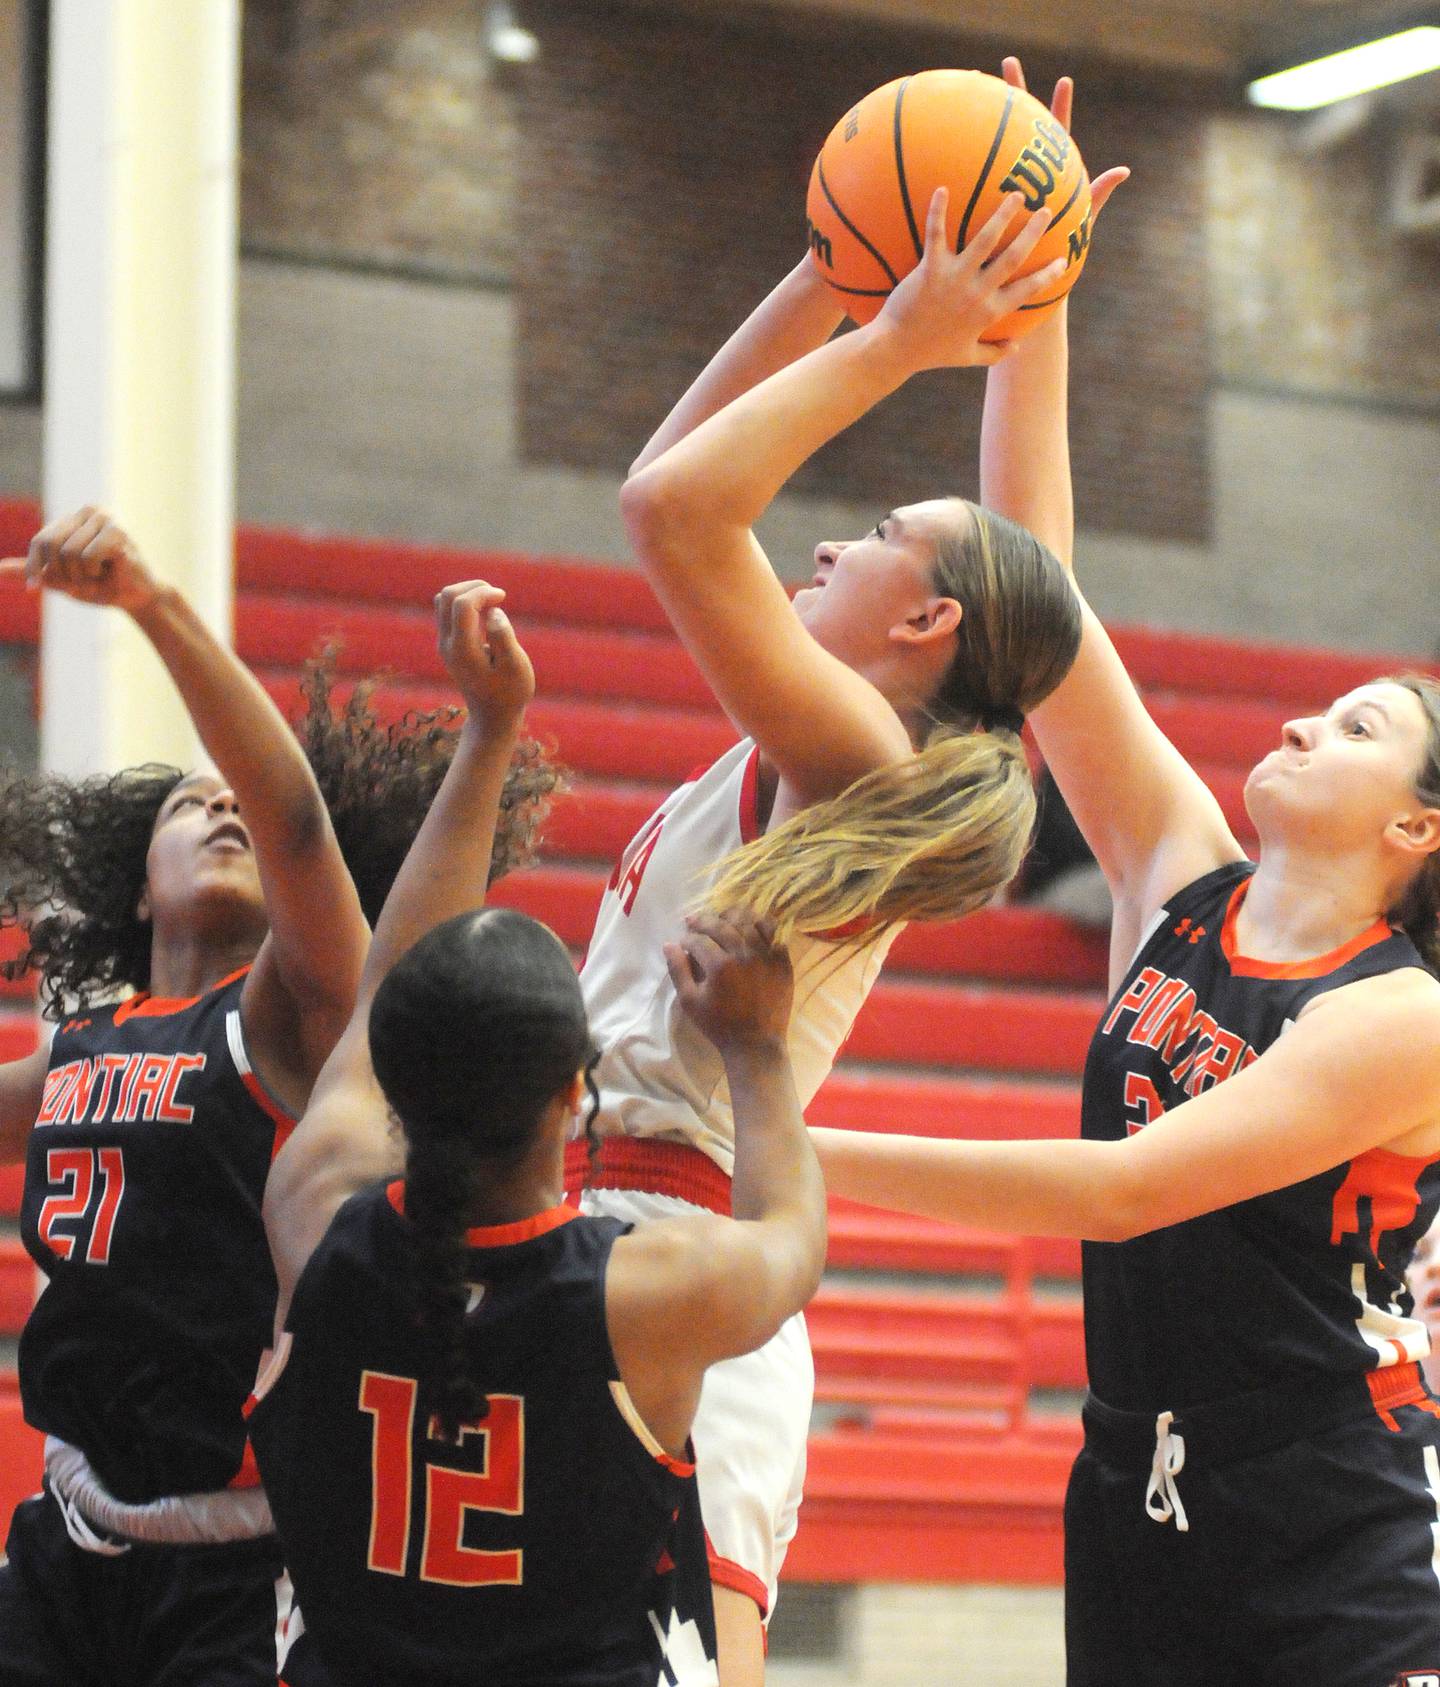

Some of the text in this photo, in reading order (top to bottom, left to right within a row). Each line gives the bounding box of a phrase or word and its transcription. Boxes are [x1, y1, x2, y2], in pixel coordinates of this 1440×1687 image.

[1102, 966, 1260, 1099] PONTIA
[37, 1147, 125, 1265] 21
[359, 1370, 525, 1587] 12
